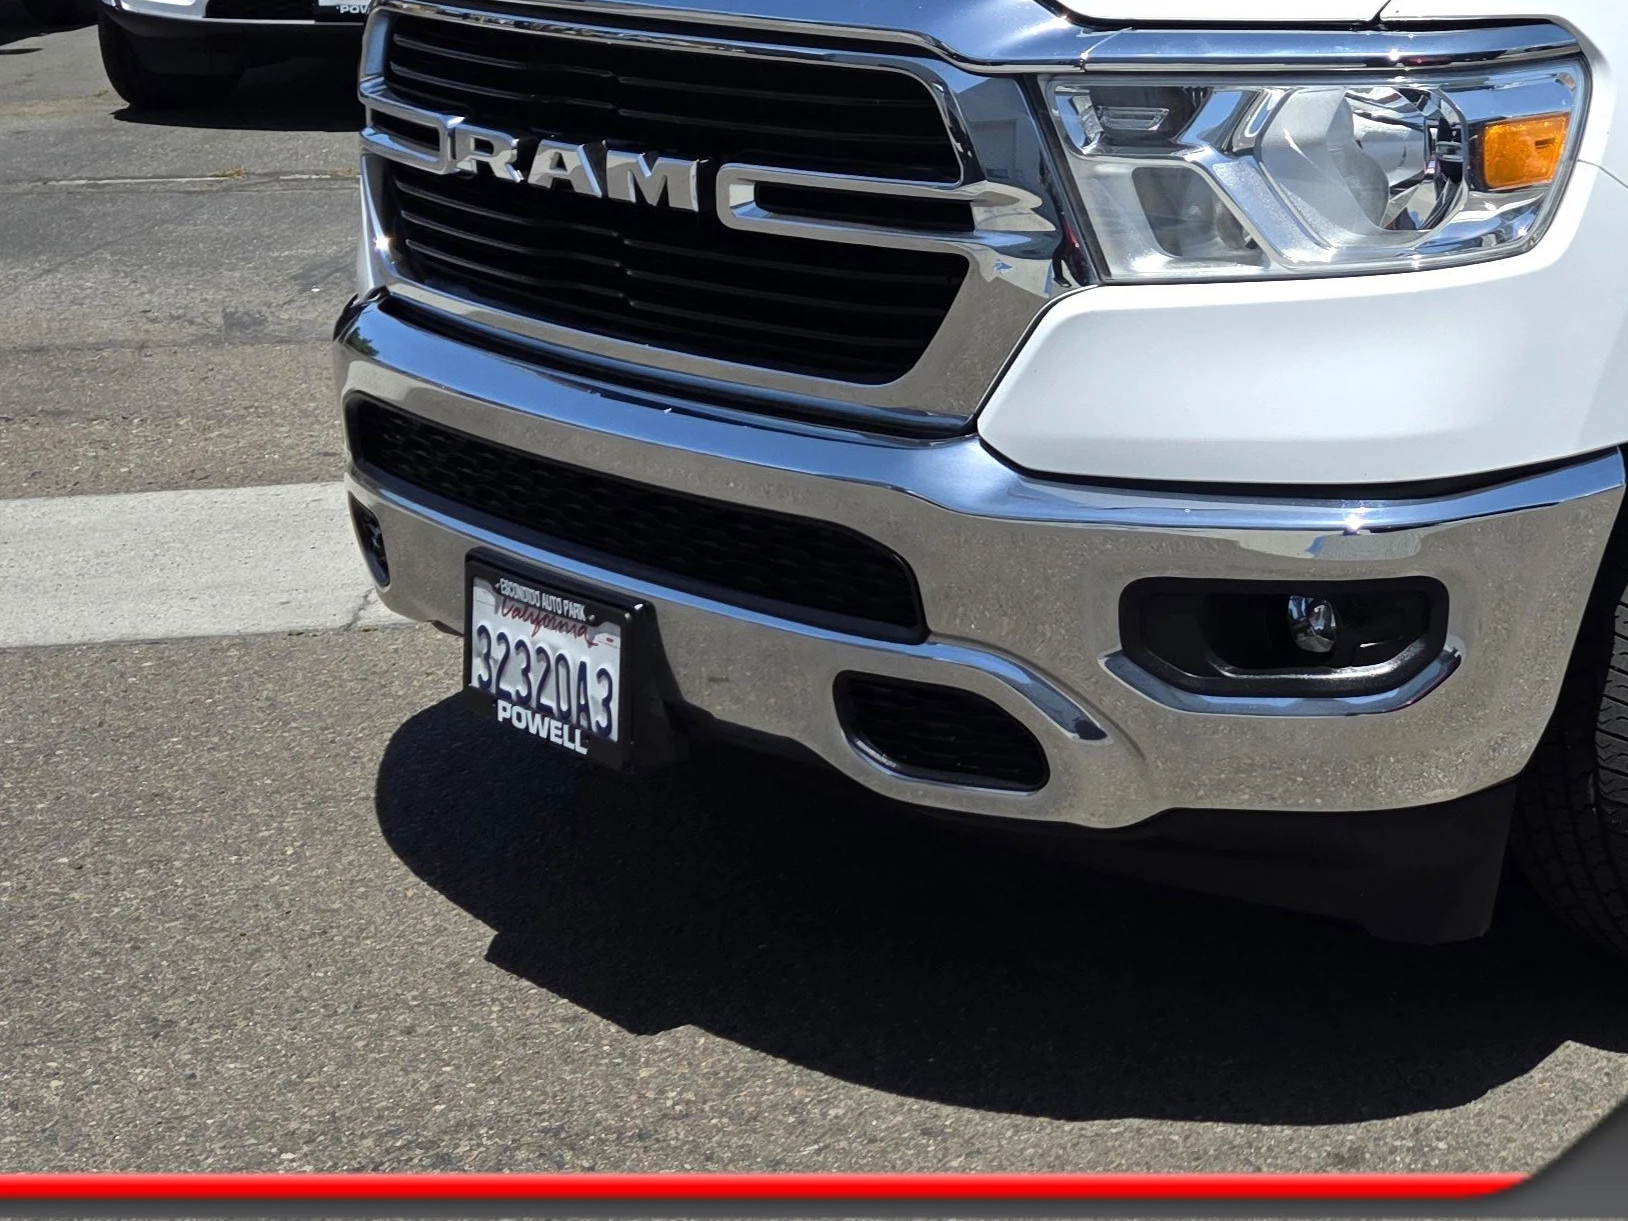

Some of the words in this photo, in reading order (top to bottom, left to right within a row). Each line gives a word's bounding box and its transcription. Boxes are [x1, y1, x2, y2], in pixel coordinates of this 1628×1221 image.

[455, 122, 699, 212] RAM
[541, 592, 563, 615] AUTO
[562, 599, 587, 622] PARK
[475, 623, 614, 738] 32320A3
[497, 699, 589, 755] POWELL
